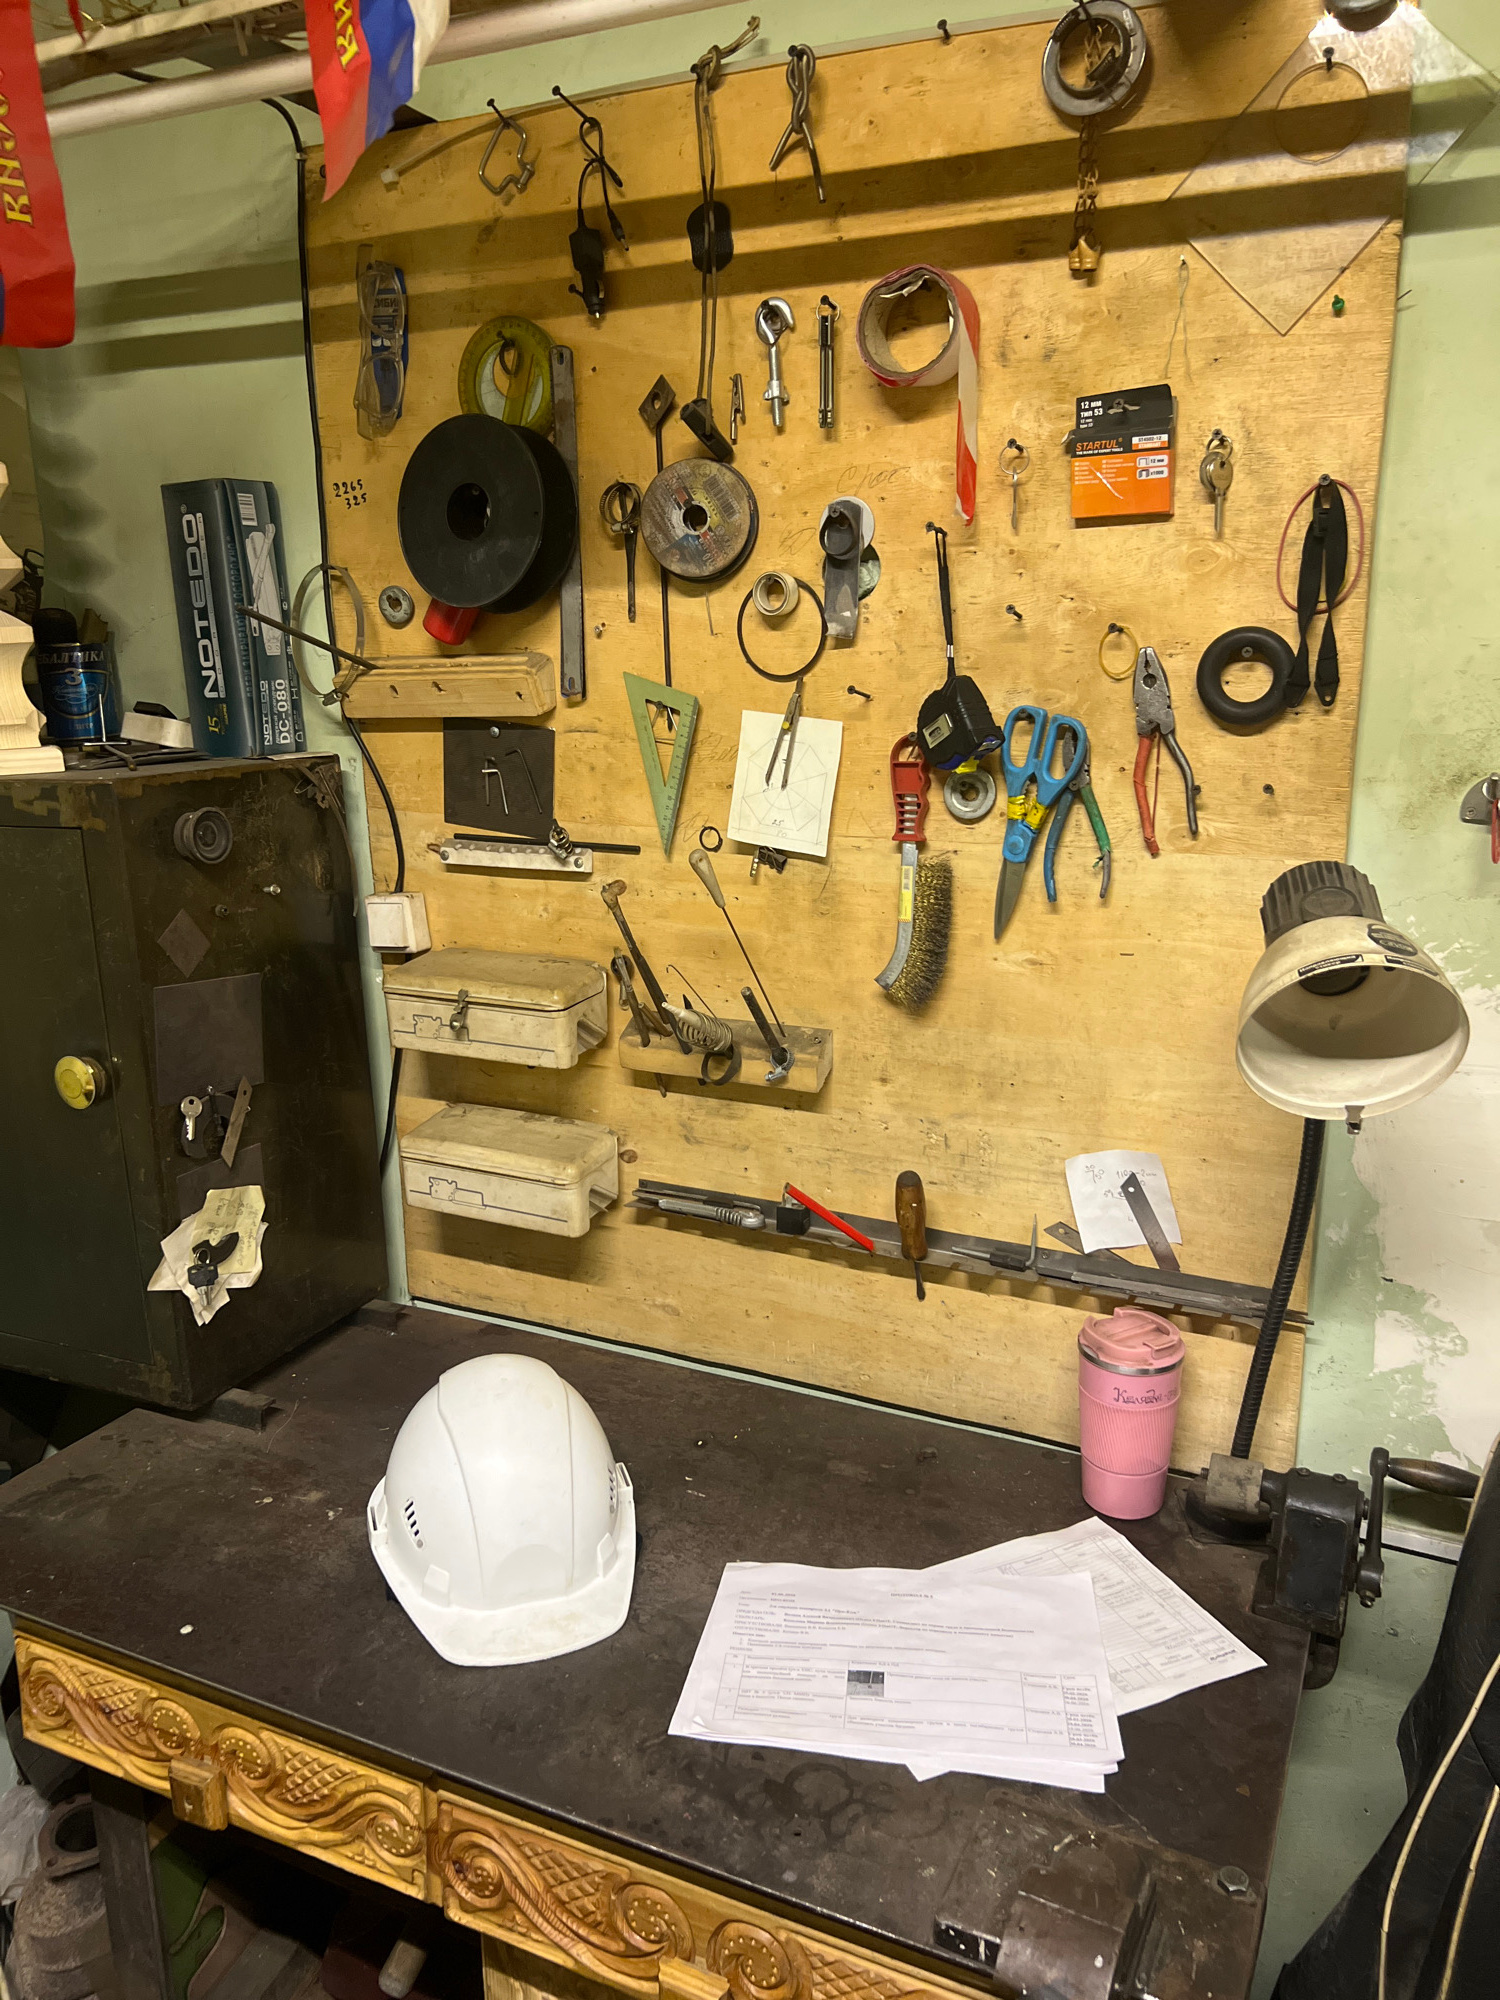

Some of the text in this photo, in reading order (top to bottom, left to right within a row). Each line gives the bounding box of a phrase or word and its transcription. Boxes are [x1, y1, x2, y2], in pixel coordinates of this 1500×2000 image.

[1094, 408, 1103, 416] 53
[1076, 439, 1119, 451] STARTUL
[333, 479, 363, 497] 2265
[345, 492, 367, 510] 325
[182, 513, 219, 698] NOTEDO
[65, 667, 82, 686] 3
[260, 680, 272, 746] NOTEDO
[274, 679, 291, 744] DC-080
[207, 715, 221, 735] 15
